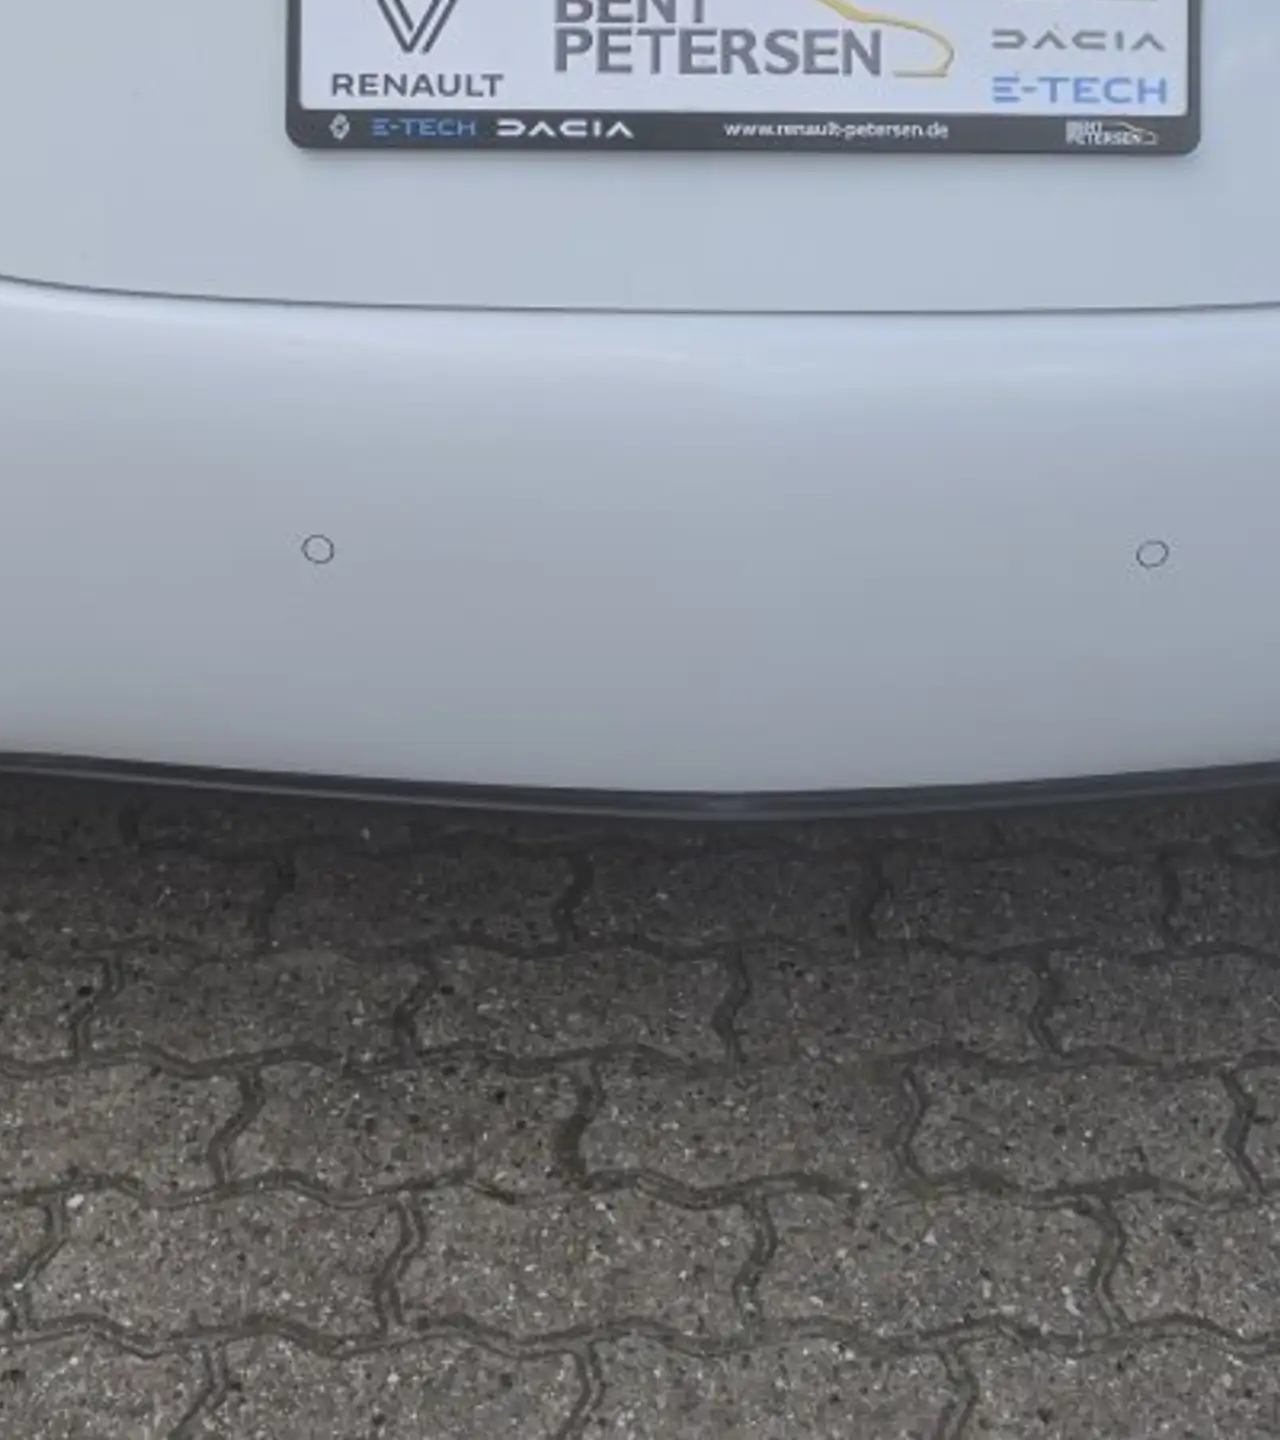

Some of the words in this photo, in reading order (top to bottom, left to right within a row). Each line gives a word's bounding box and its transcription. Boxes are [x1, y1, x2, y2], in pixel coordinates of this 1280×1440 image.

[554, 27, 881, 77] PETERSEN
[991, 28, 1166, 52] DACIA
[331, 73, 504, 98] RENAULT
[991, 75, 1167, 105] E-TECH
[370, 118, 476, 137] E-TECH
[495, 118, 634, 139] DACIA
[723, 121, 949, 141] www.renault-petersen.de
